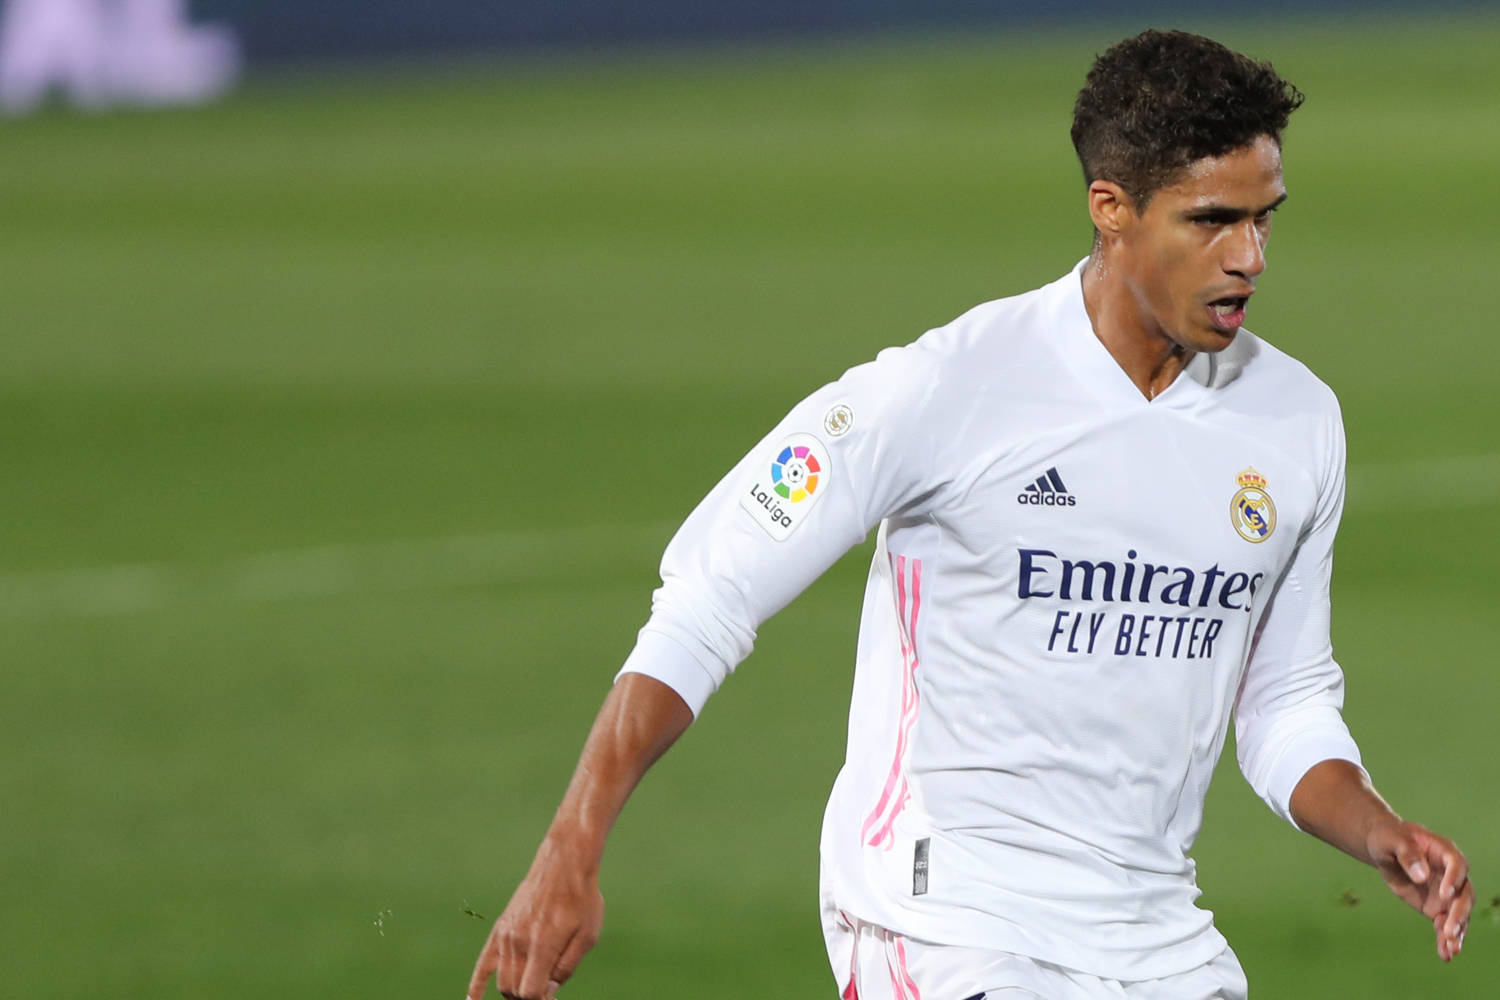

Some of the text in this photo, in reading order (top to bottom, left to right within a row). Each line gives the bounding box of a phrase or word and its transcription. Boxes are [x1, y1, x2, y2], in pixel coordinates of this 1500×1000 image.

[750, 484, 793, 528] LaLiga
[1017, 491, 1076, 507] adidas
[1017, 548, 1263, 612] Emirates
[1048, 610, 1224, 659] FLY BETTER
